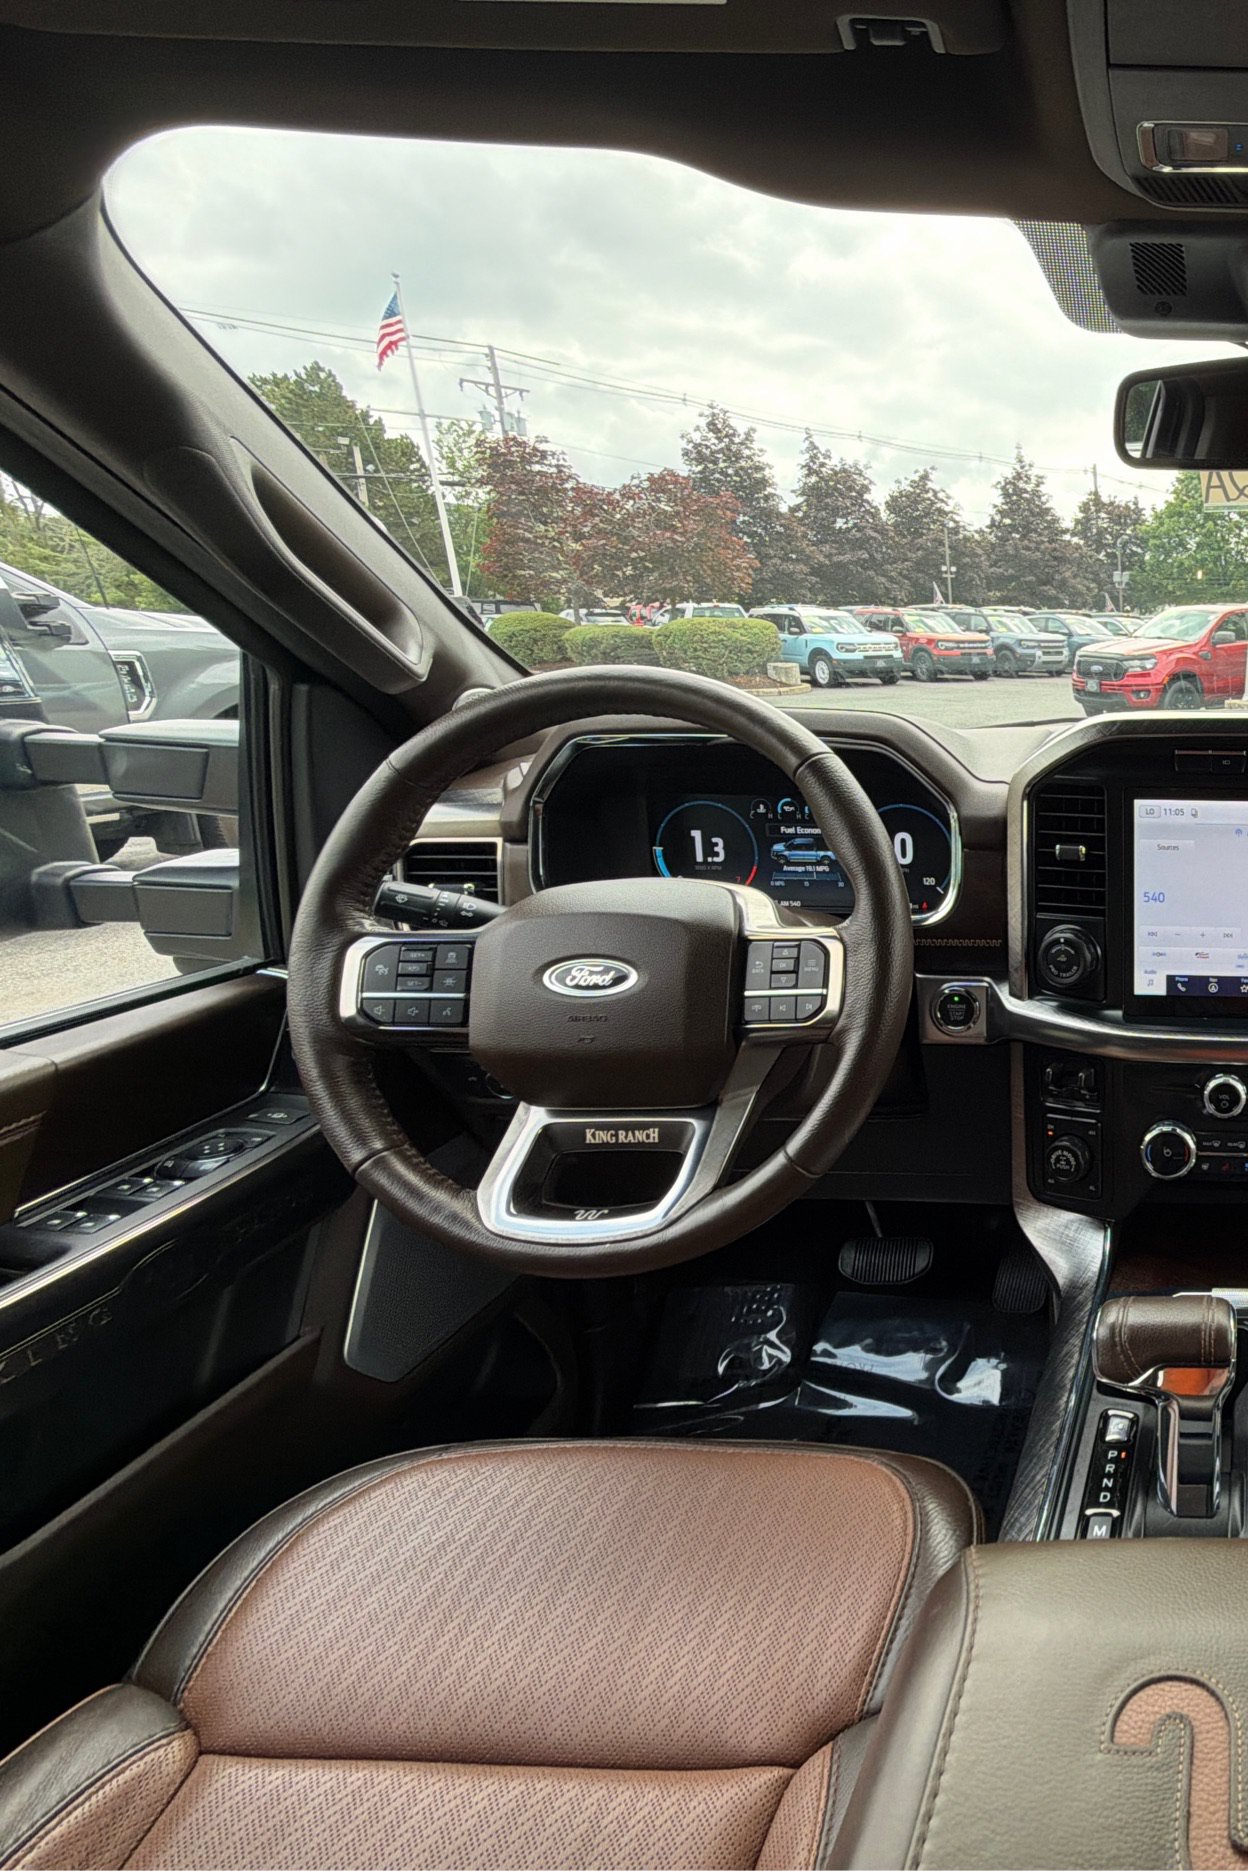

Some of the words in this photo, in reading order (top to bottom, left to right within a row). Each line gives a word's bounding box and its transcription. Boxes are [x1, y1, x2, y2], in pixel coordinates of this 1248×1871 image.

[1163, 807, 1185, 816] 11:05
[780, 826, 796, 835] Fuel
[690, 829, 726, 863] 1.3
[1156, 843, 1180, 851] Sources
[782, 865, 805, 873] Average
[922, 877, 936, 886] 120
[1143, 891, 1166, 903] 540
[565, 965, 616, 987] Ford
[584, 1128, 616, 1144] KING
[617, 1127, 660, 1144] RANCH
[1107, 1450, 1118, 1460] P
[1104, 1463, 1116, 1474] R
[1102, 1477, 1114, 1488] N
[1099, 1491, 1111, 1503] D
[1092, 1524, 1107, 1537] M
